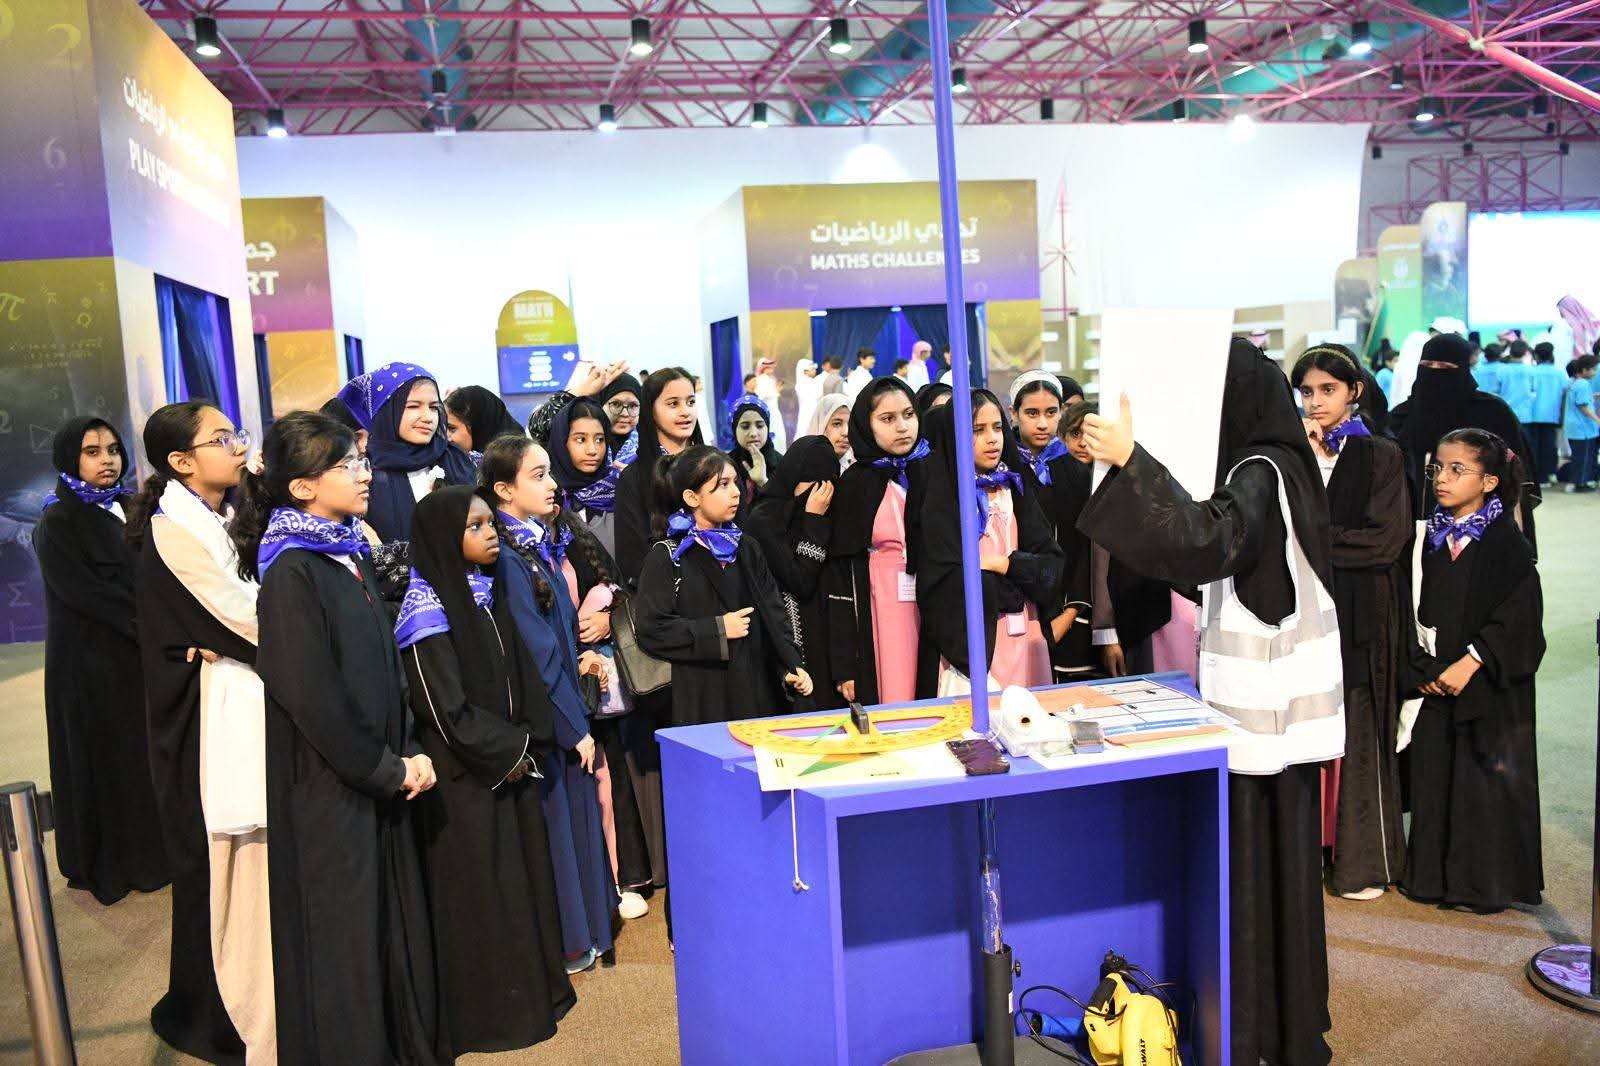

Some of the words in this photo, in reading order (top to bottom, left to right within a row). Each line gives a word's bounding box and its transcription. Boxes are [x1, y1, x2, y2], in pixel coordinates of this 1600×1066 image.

[128, 137, 157, 184] PLAY
[810, 219, 911, 246] الرياضيات
[913, 217, 978, 243] تحي
[811, 253, 870, 270] MATHS
[872, 248, 981, 268] CHALLENES
[248, 271, 279, 296] RT
